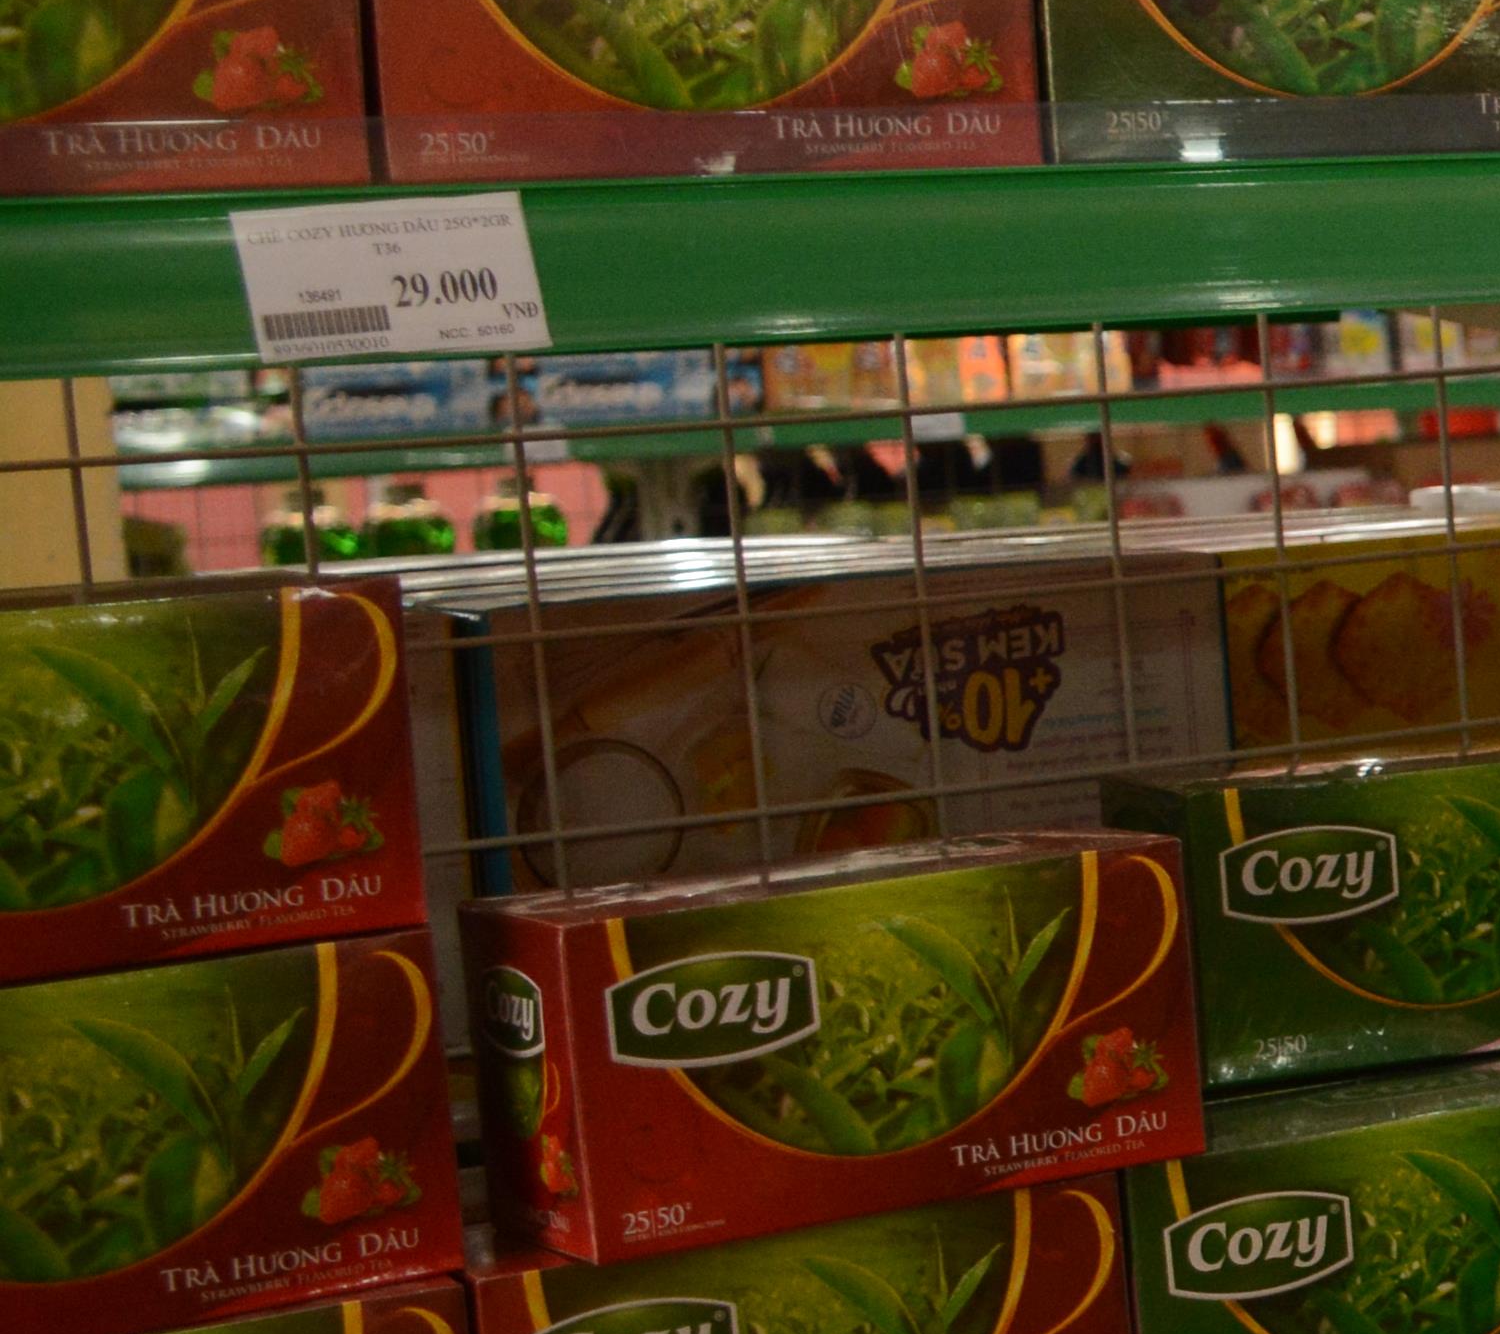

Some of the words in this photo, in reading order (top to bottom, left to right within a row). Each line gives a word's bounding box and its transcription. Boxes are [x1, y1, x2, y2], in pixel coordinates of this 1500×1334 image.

[393, 267, 497, 308] 29.000
[978, 621, 1060, 661] KEM
[1241, 846, 1376, 900] Cozy
[632, 974, 793, 1038] Cozy
[1187, 1214, 1329, 1273] Cozy
